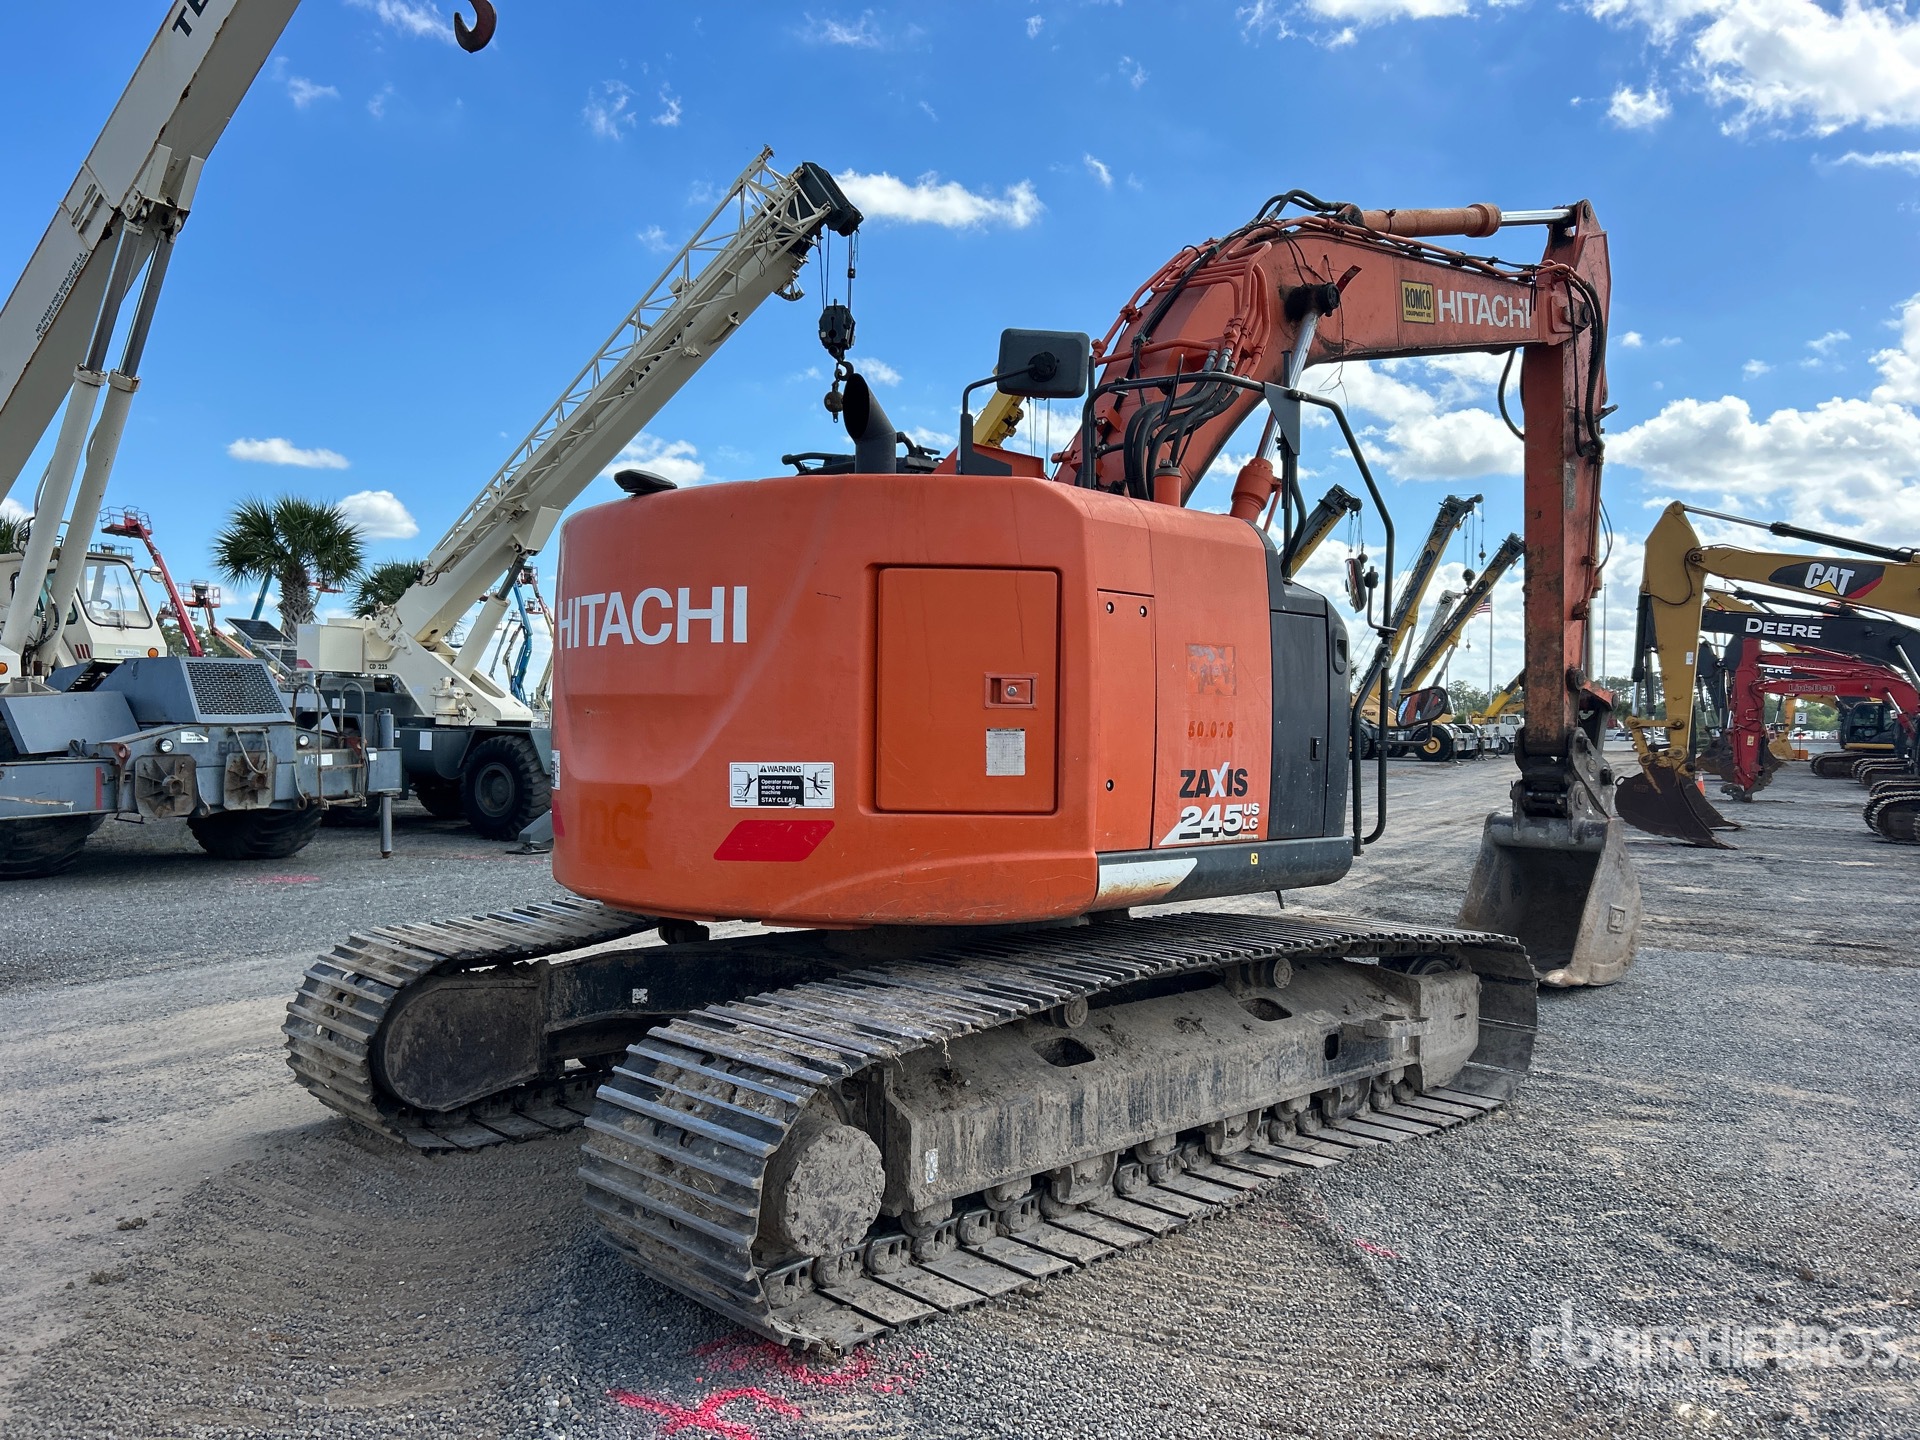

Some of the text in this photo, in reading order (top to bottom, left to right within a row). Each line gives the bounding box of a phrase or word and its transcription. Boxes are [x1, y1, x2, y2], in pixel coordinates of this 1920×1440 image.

[35, 252, 83, 334] NO PASAR POR DEBAJO DE LA
[36, 252, 89, 341] PLUMA ESTANDO EN OPERACION
[1404, 287, 1432, 311] ROMCO
[1437, 289, 1531, 329] HITACHI
[1804, 562, 1856, 596] CAT
[558, 585, 748, 650] HITACHI
[1745, 617, 1822, 639] DEERE
[767, 765, 801, 773] WARNING
[1179, 762, 1249, 798] ZAXIS
[1179, 803, 1260, 838] 245 US
[1242, 817, 1259, 831] LC
